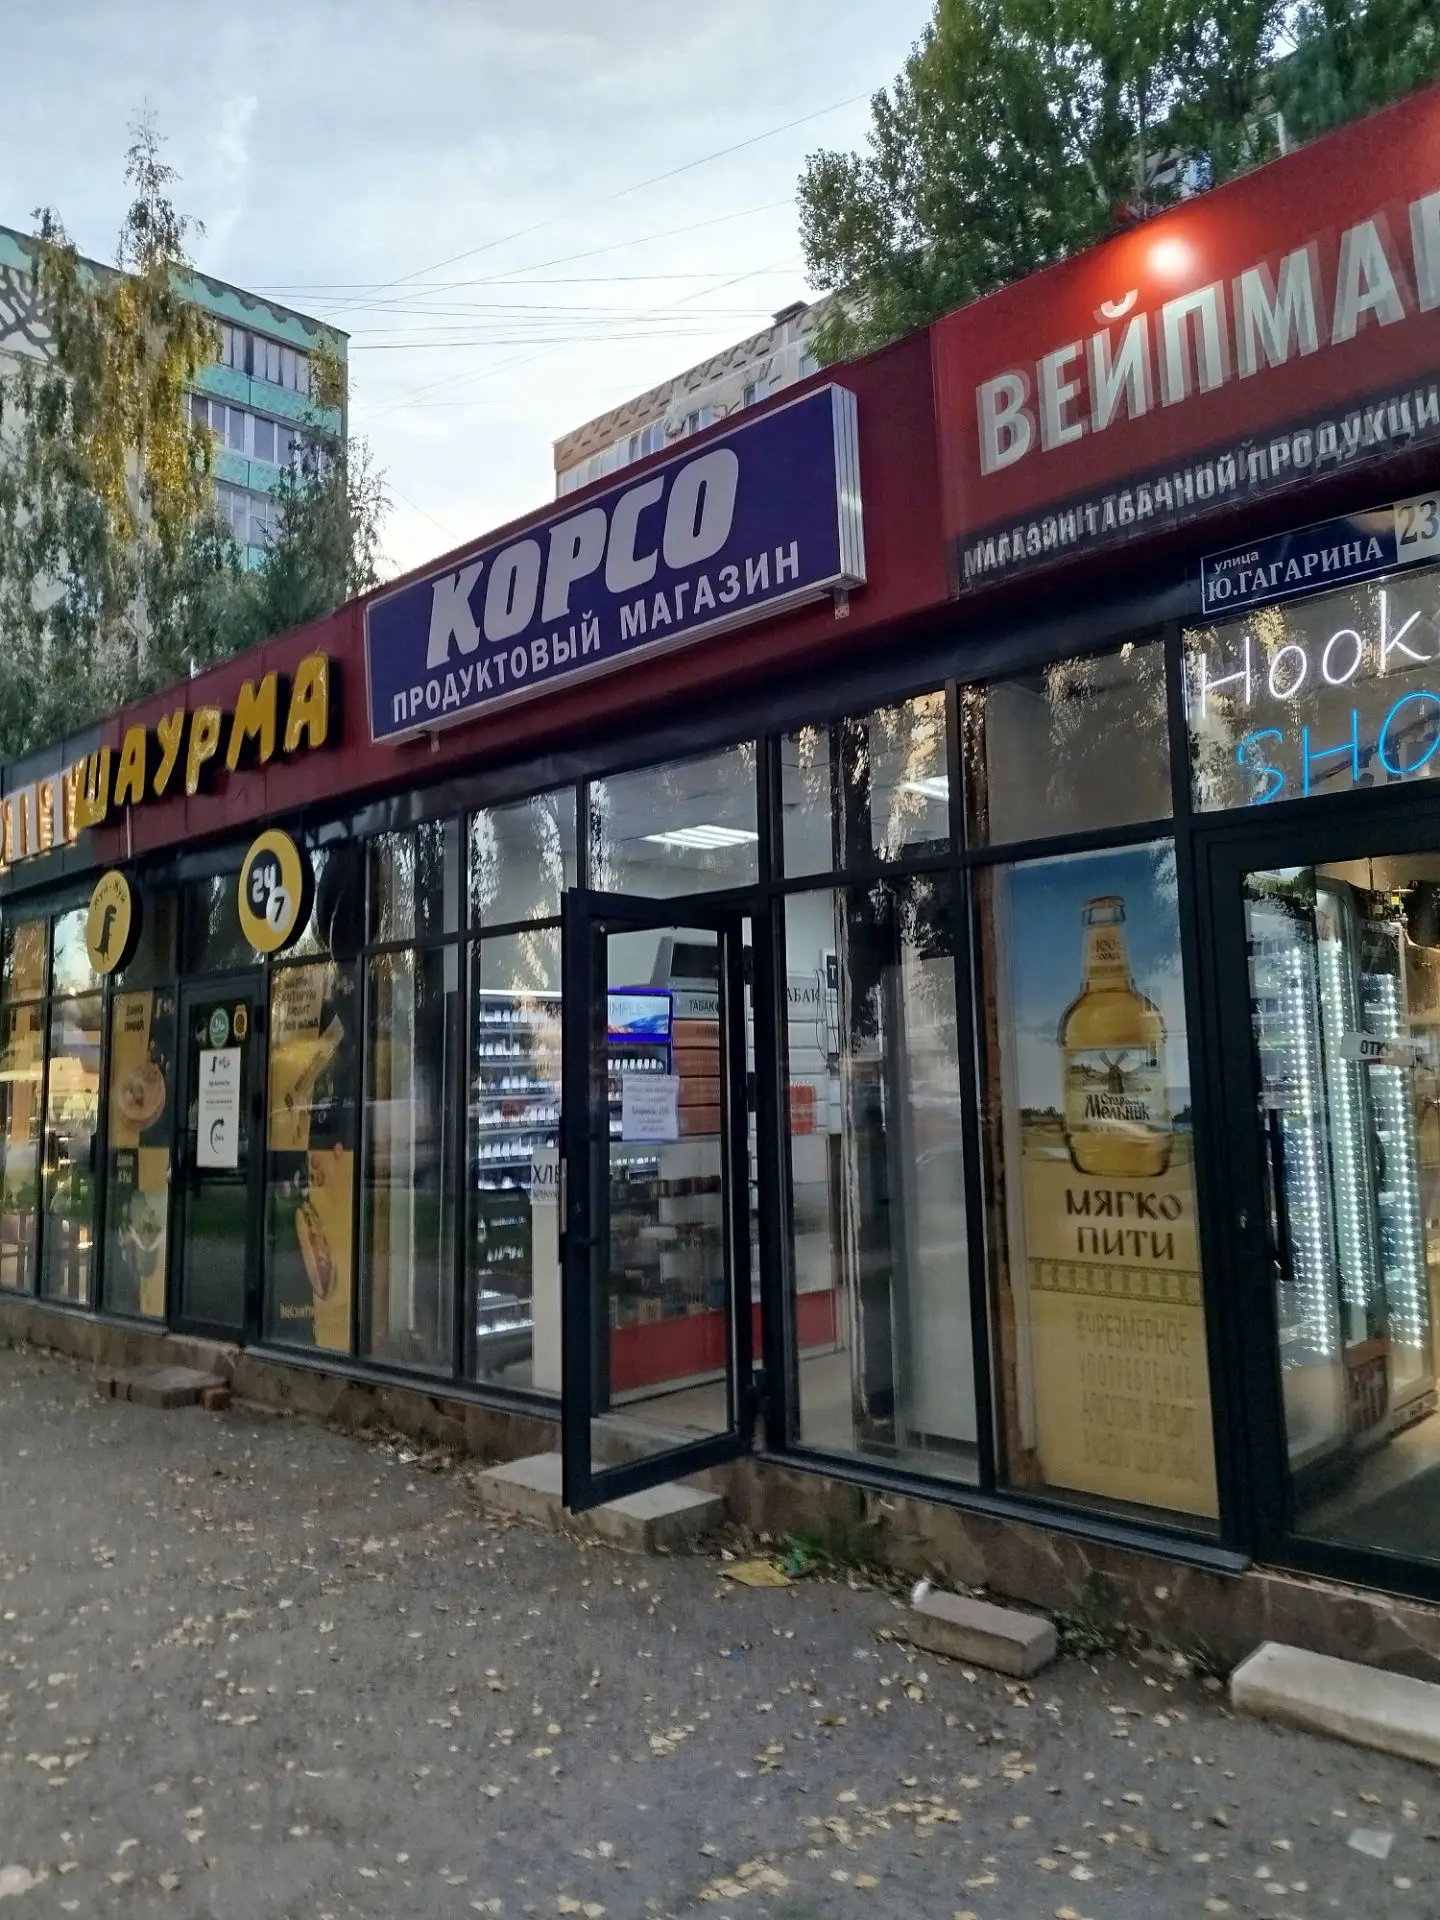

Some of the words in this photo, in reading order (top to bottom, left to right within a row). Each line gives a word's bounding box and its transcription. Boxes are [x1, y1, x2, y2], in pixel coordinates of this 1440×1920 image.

[964, 508, 1088, 578] МАГАЗИН
[1085, 452, 1240, 533] ТАБАЧНОЙ
[1247, 386, 1440, 484] ПРОДУКЦИ
[1398, 499, 1440, 546] 23
[425, 447, 739, 670] КОРСО
[1207, 536, 1385, 603] Ю.ГАГАРИНА
[1213, 549, 1260, 575] улица
[392, 610, 601, 724] ПРОДУКТОВЫЙ
[620, 541, 800, 641] МАГАЗИН
[74, 651, 329, 834] ШАУРМА
[252, 864, 276, 903] 24
[1065, 1188, 1183, 1222] МЯГКО
[1076, 1226, 1176, 1261] ПИТИ
